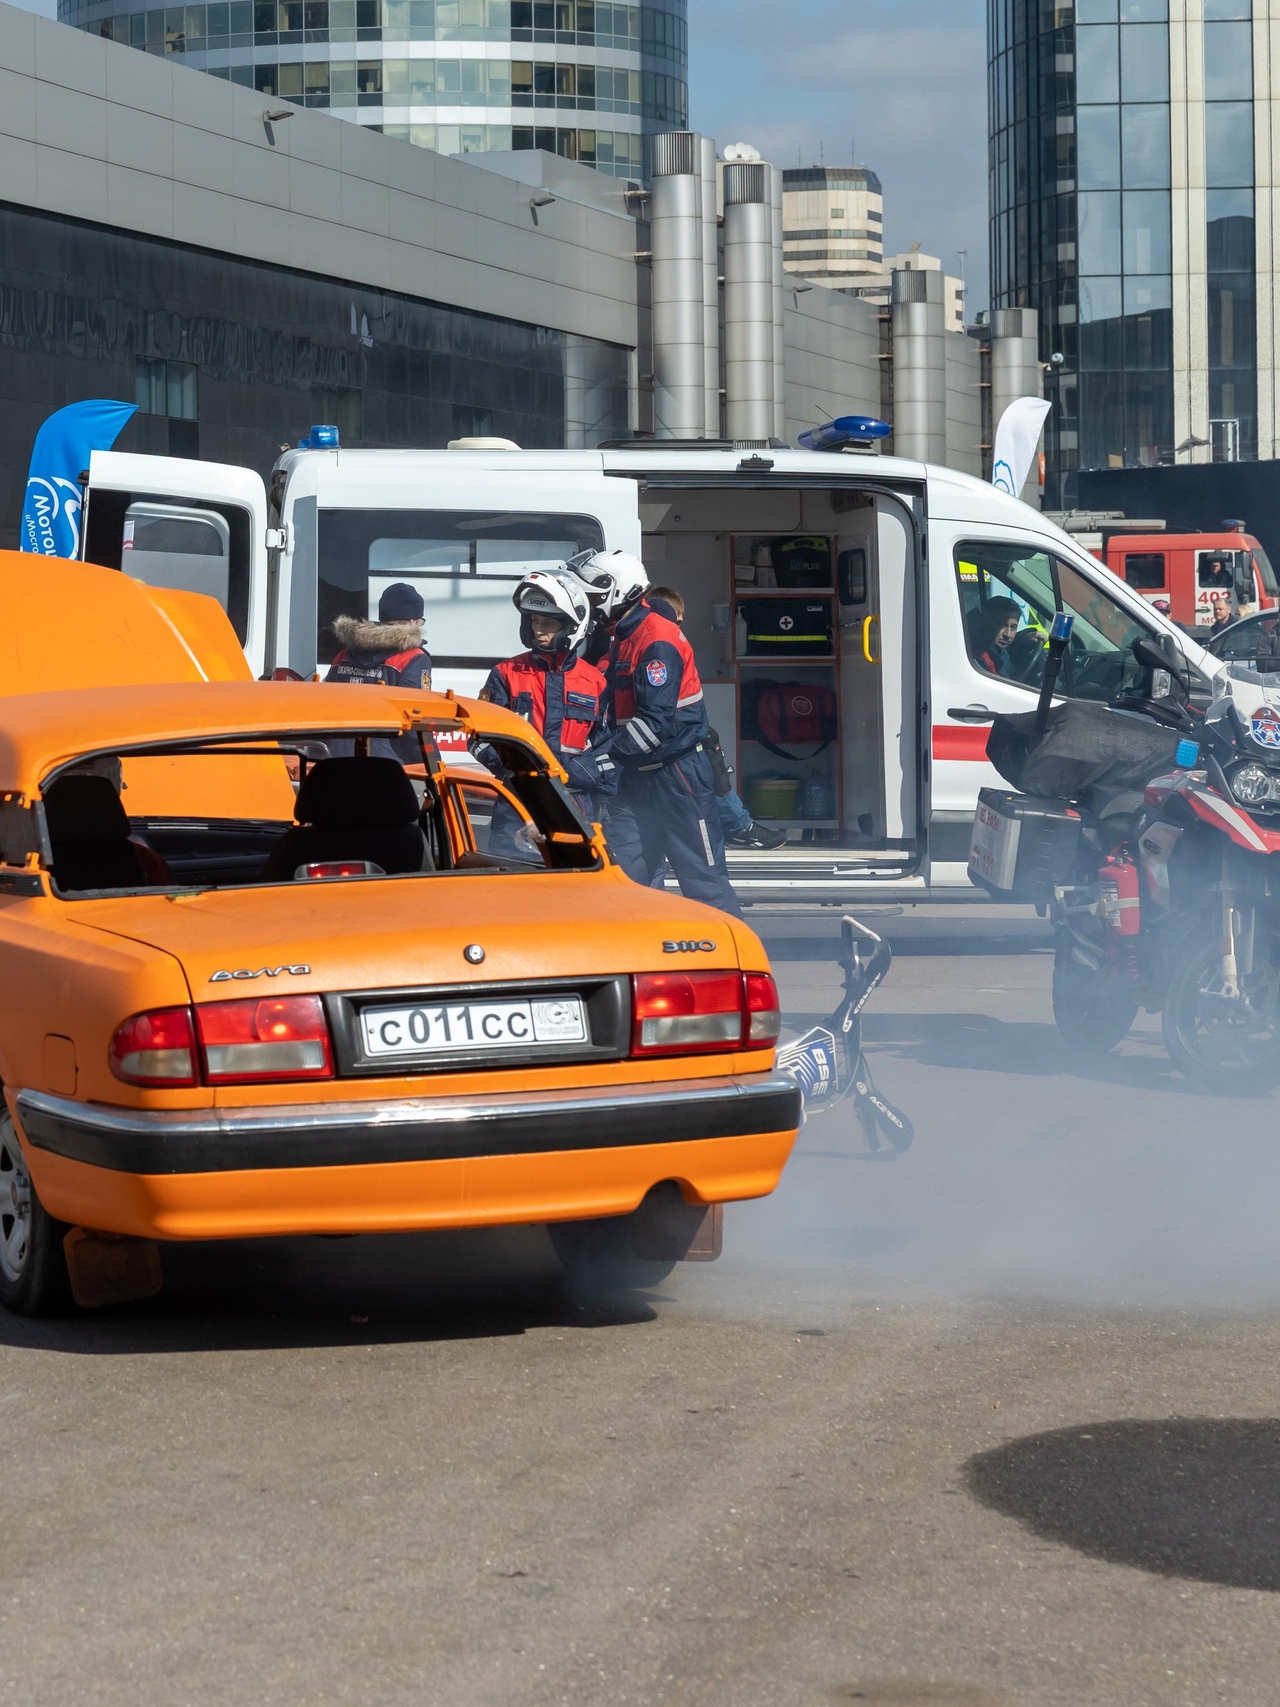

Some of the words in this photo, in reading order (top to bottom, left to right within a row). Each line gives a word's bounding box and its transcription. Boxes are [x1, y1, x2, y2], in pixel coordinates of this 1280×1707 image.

[1143, 838, 1163, 855] GS
[662, 939, 717, 953] 3110
[812, 1048, 829, 1095] BSE
